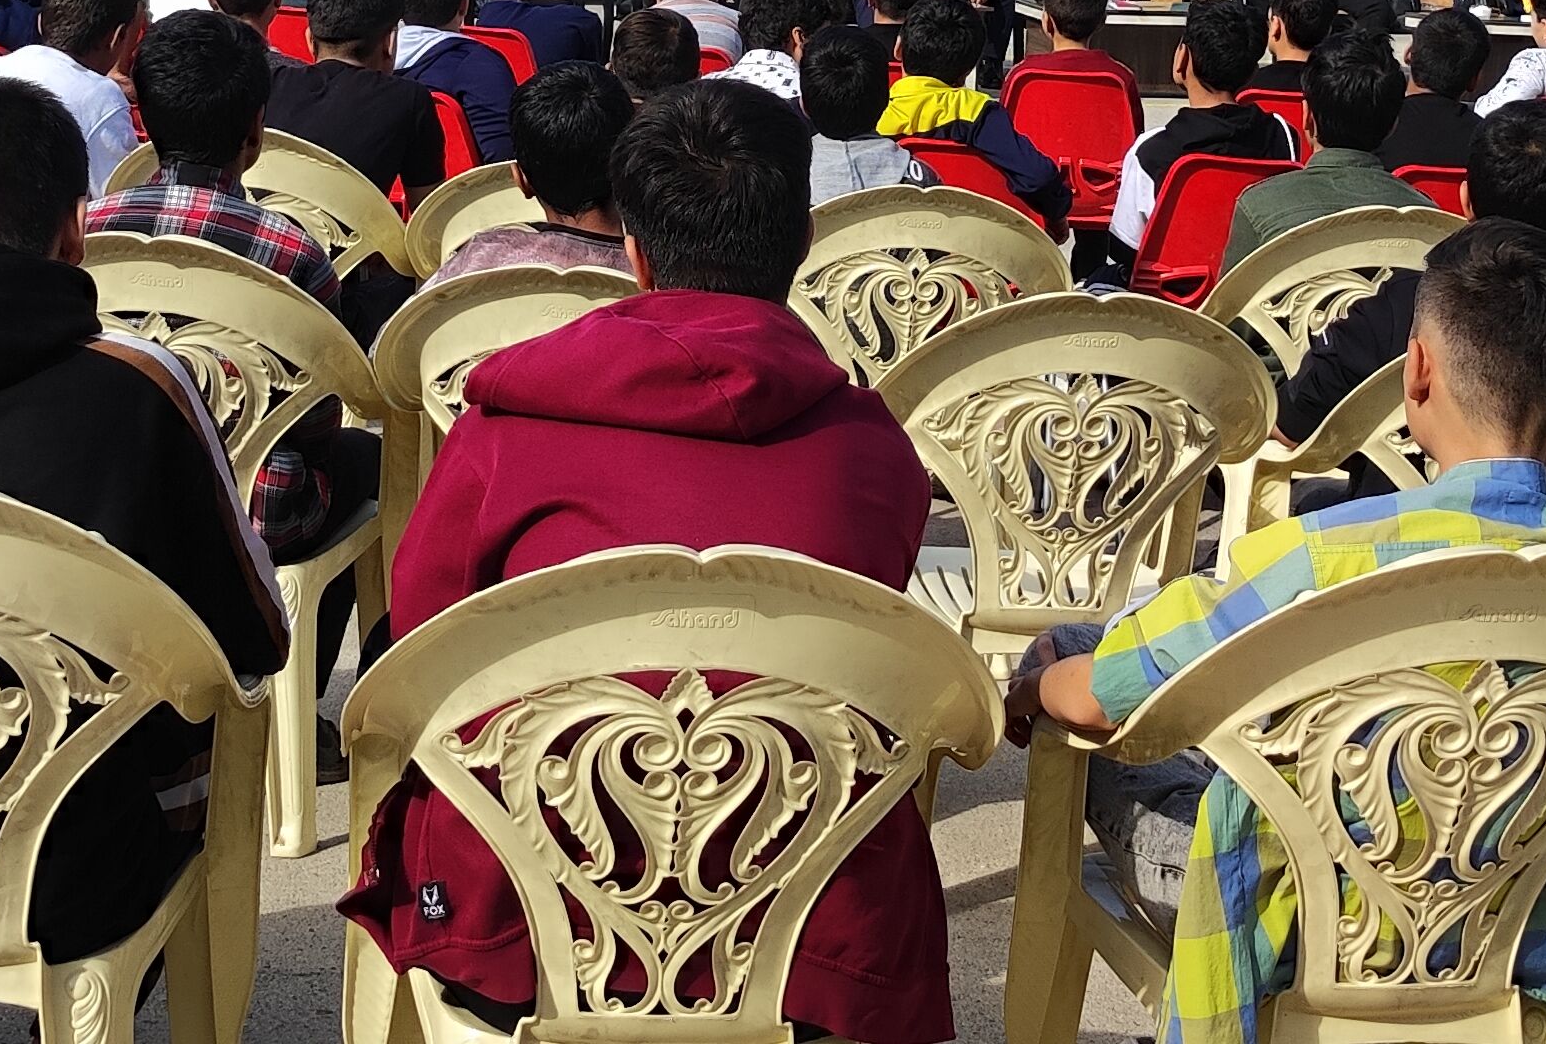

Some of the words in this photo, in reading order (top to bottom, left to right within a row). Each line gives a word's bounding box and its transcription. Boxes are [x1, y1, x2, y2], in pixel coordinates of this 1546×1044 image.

[130, 271, 185, 289] Sahand
[1063, 334, 1120, 349] Sahand
[650, 608, 740, 629] Sahand
[1459, 603, 1540, 623] Sahand
[423, 904, 445, 916] FOX
